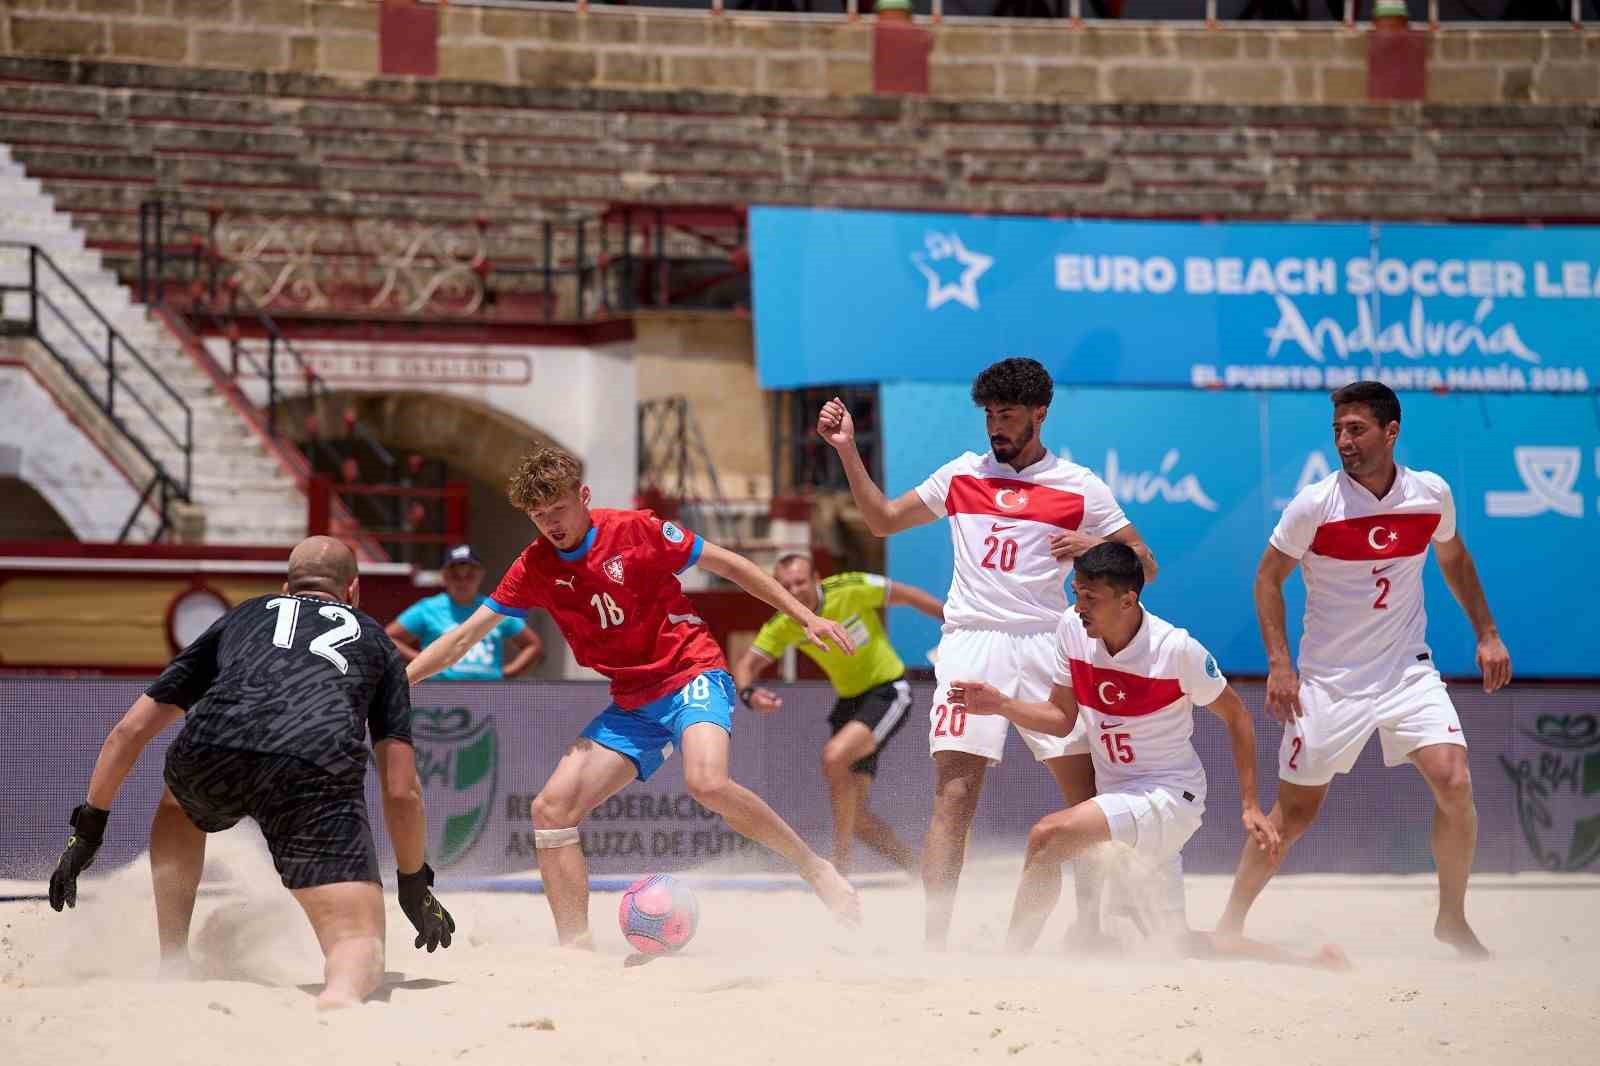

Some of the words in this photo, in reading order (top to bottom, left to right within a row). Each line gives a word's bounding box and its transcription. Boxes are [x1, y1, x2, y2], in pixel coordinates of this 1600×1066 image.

[1055, 253, 1176, 293] EURO
[1184, 256, 1337, 296] BEACH
[1346, 257, 1525, 298] SOCCER
[1533, 260, 1600, 299] LE
[1265, 292, 1541, 364] Andalucía
[1225, 365, 1323, 390] PUERTO
[981, 535, 1019, 573] 20
[1373, 576, 1392, 609] 2
[590, 591, 625, 630] 18
[265, 597, 361, 675] 12
[681, 674, 711, 704] 18
[934, 704, 967, 737] 20
[1101, 733, 1135, 764] 15
[1289, 737, 1302, 769] 2
[653, 831, 684, 856] DE
